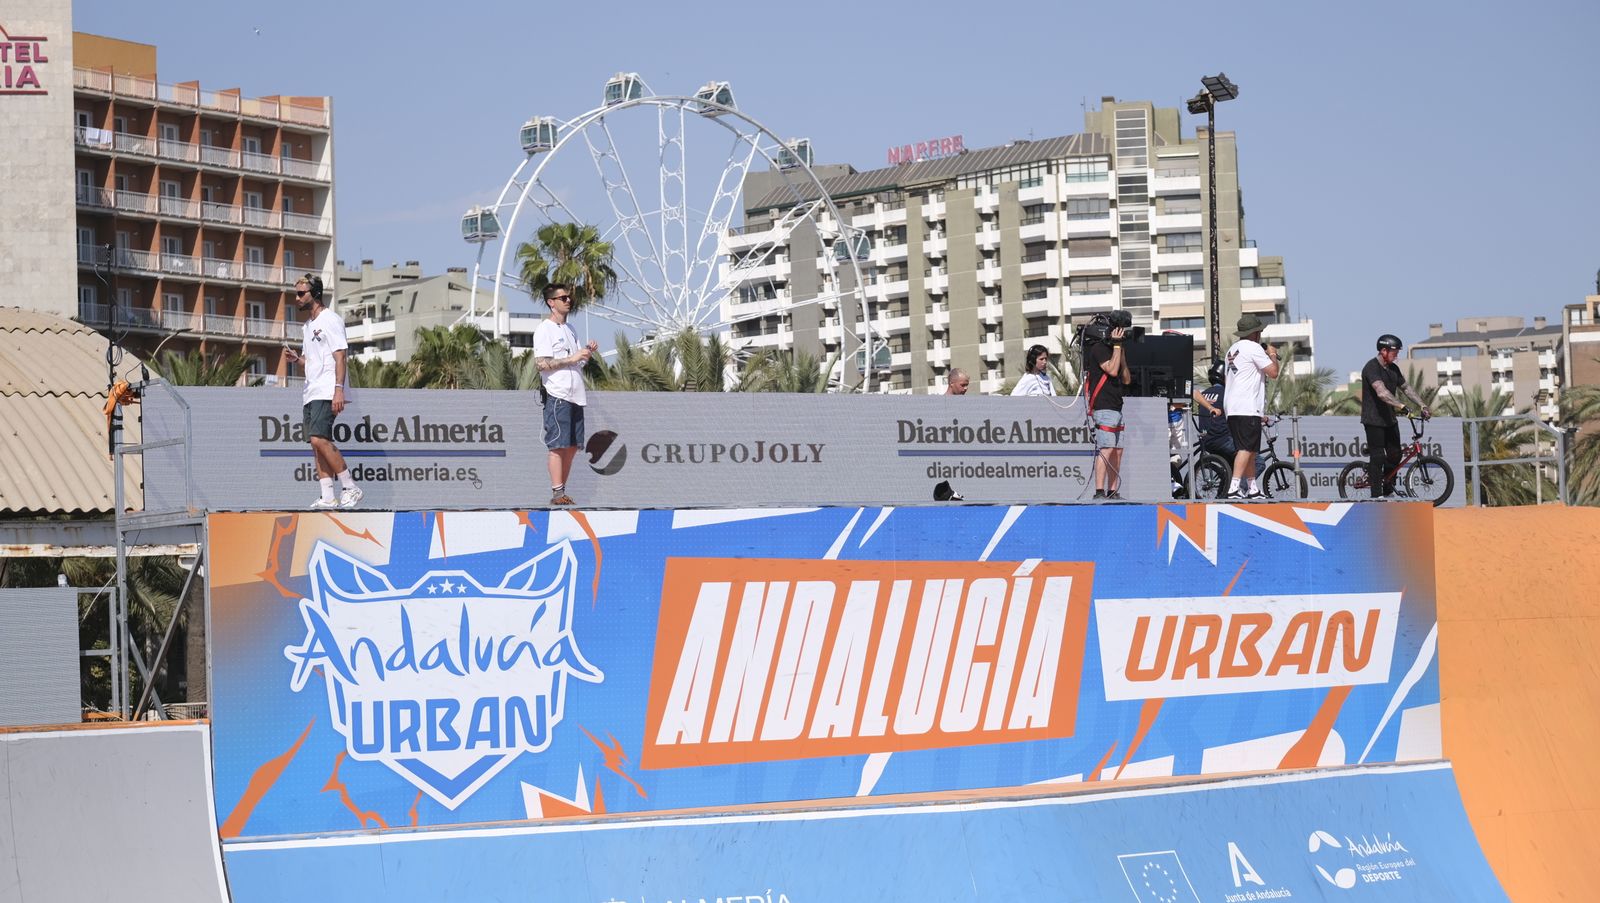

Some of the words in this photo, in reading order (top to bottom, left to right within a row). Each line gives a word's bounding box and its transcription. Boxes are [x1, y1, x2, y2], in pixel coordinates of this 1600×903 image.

[0, 42, 48, 63] TEL
[887, 135, 963, 164] MAPFRE
[259, 414, 351, 442] Diao
[391, 415, 505, 443] Almería
[294, 463, 478, 482] diadealmeria.es
[926, 461, 1081, 479] diariodealmeria.es
[290, 599, 602, 688] Andalucía
[655, 558, 1073, 746] ANDALUCÍA
[1124, 609, 1381, 682] URBAN
[351, 695, 548, 755] URBAN
[1361, 870, 1402, 883] DEPORTE
